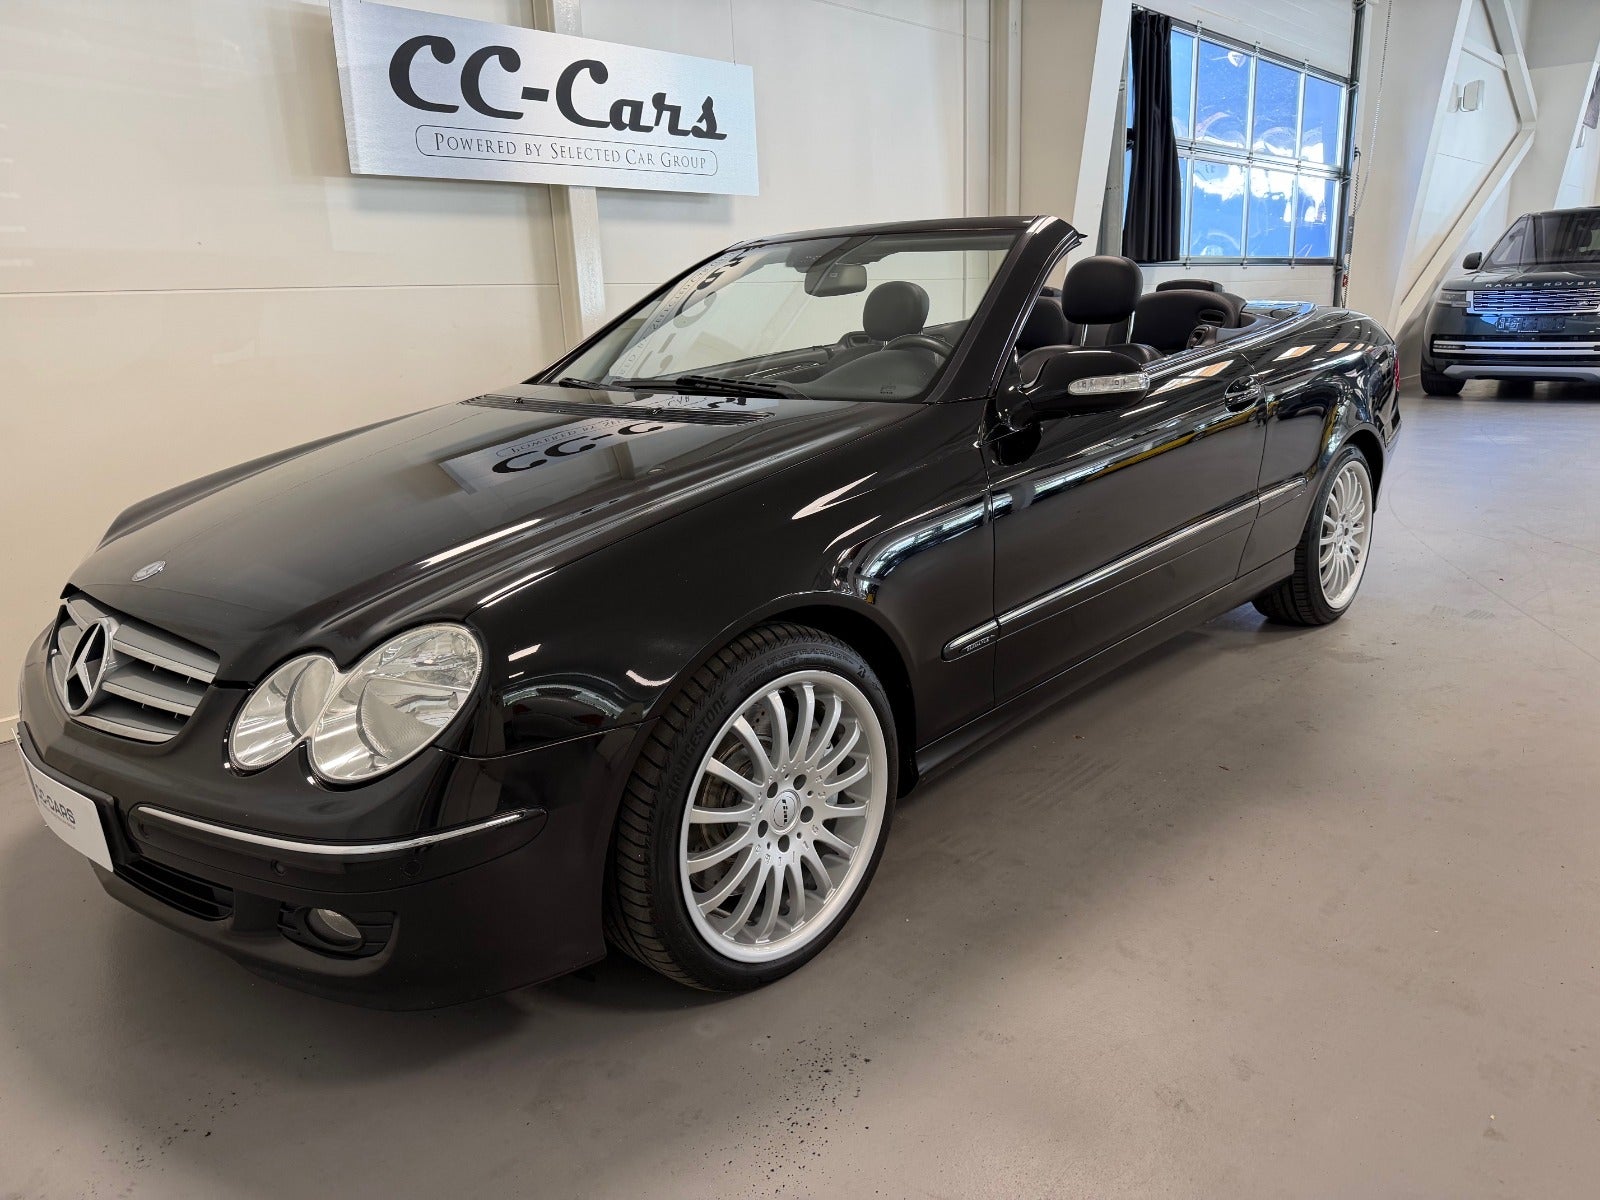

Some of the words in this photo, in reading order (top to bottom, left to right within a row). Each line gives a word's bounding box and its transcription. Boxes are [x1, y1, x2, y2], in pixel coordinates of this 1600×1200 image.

[389, 35, 727, 140] CC-Cars
[434, 132, 516, 155] POWERED
[525, 143, 543, 157] BY
[550, 142, 620, 163] SELECTED
[626, 149, 654, 166] CAR
[660, 151, 707, 169] GROUP
[35, 784, 76, 825] C-CARS
